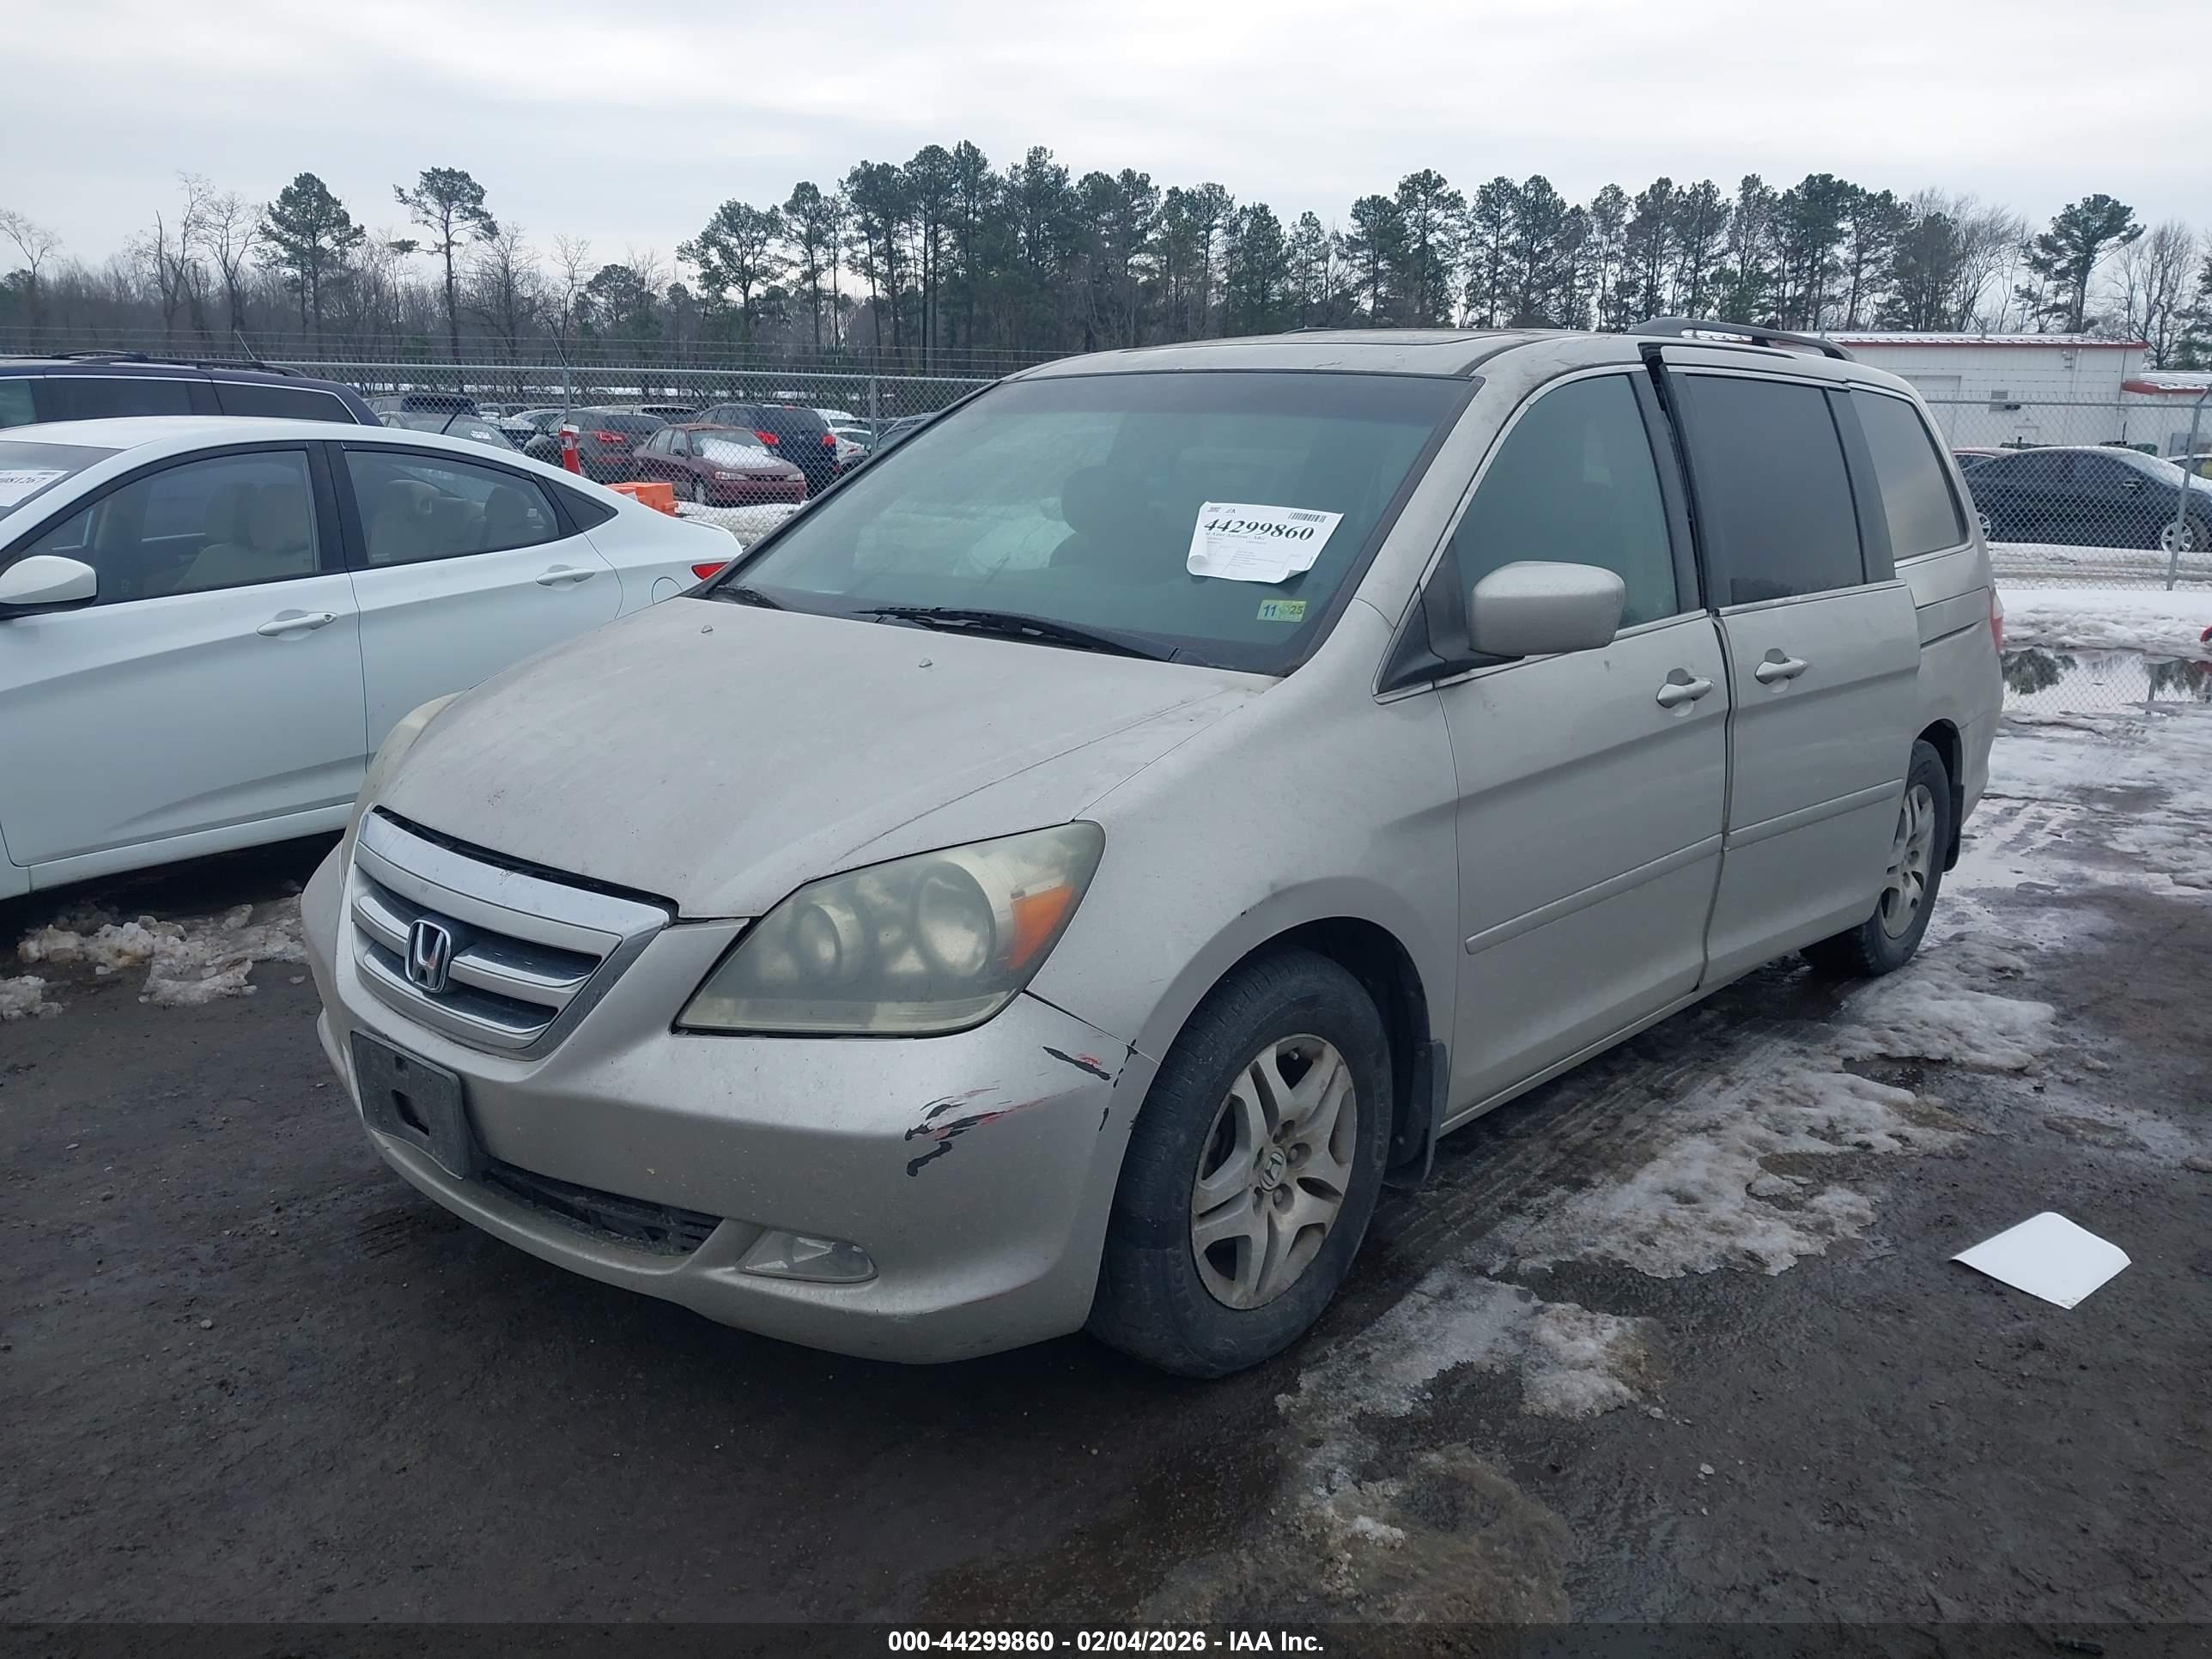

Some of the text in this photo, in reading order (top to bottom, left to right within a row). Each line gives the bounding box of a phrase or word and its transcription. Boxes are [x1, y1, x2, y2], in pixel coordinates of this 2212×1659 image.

[1204, 519, 1315, 541] 44299860
[1263, 605, 1304, 617] 11 25
